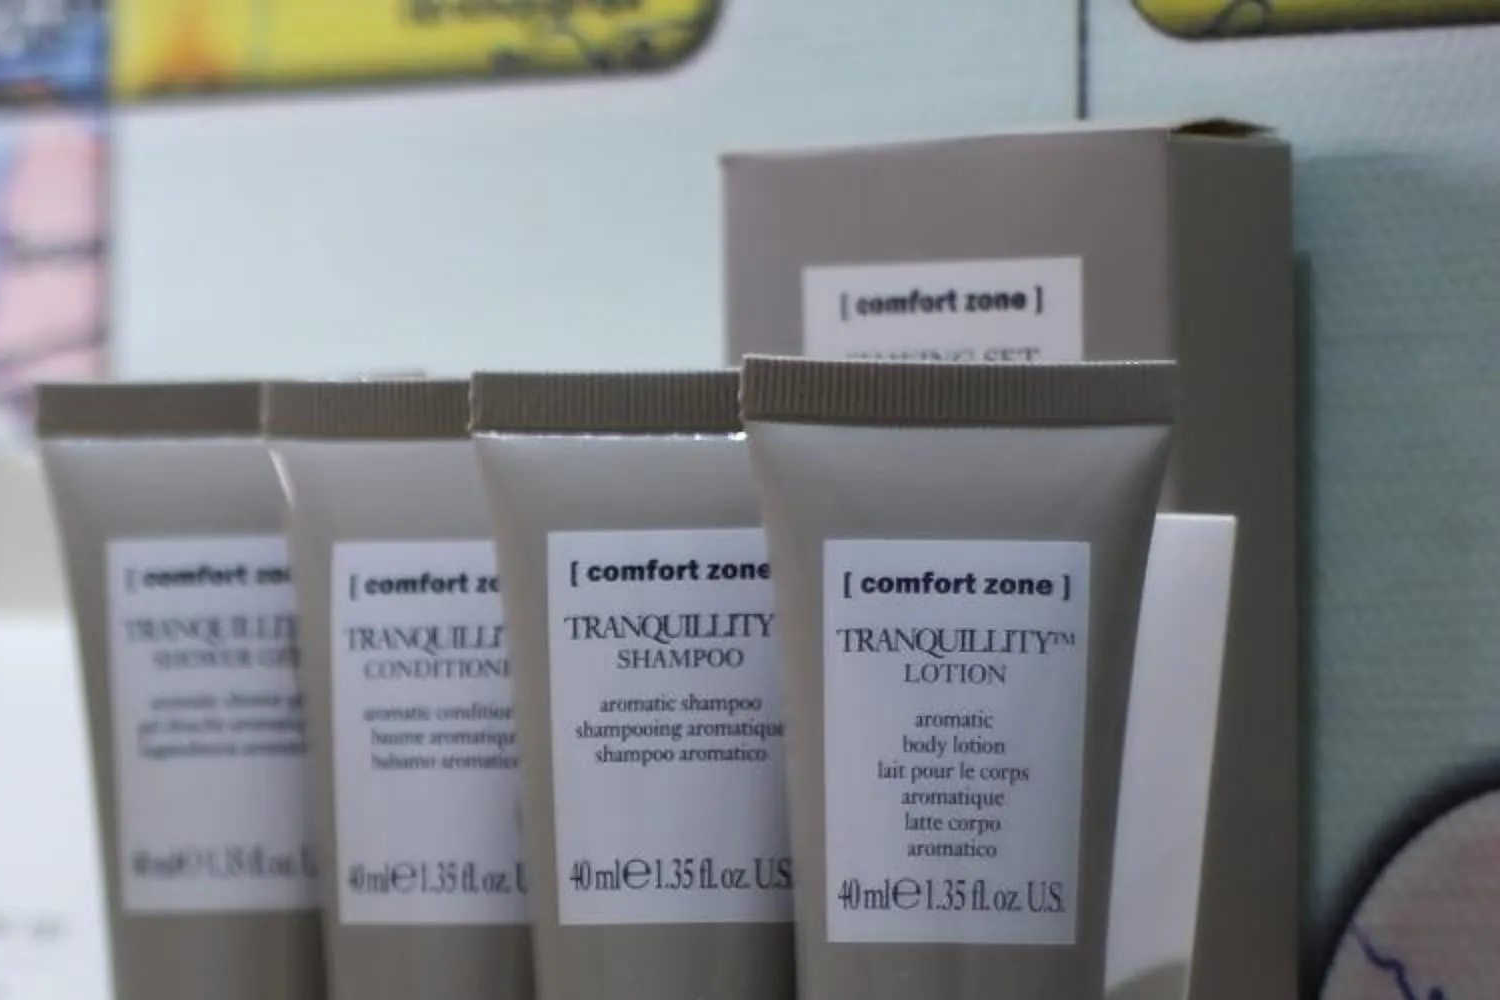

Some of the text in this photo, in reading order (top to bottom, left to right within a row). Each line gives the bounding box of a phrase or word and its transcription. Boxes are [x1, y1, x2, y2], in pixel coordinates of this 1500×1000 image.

[855, 288, 957, 315] comfort
[964, 291, 1027, 312] zone
[586, 559, 699, 582] comfort
[706, 562, 771, 581] zone
[364, 572, 469, 595] comfort
[860, 571, 976, 595] comfort
[982, 576, 1053, 595] zone
[345, 625, 504, 656] TRANQUILLI
[615, 648, 745, 670] SHAMPOO
[903, 663, 1007, 685] LOTION
[599, 692, 763, 716] aromatic shampoo
[914, 709, 995, 729] aromatic
[574, 720, 683, 743] shampooing
[595, 744, 768, 767] shampoo aromatico
[902, 735, 1006, 759] body lotion
[876, 760, 1030, 787] lait pour le corps
[900, 786, 1006, 810] aromatique
[904, 811, 1002, 836] latte corpo
[906, 838, 998, 859] aromatico
